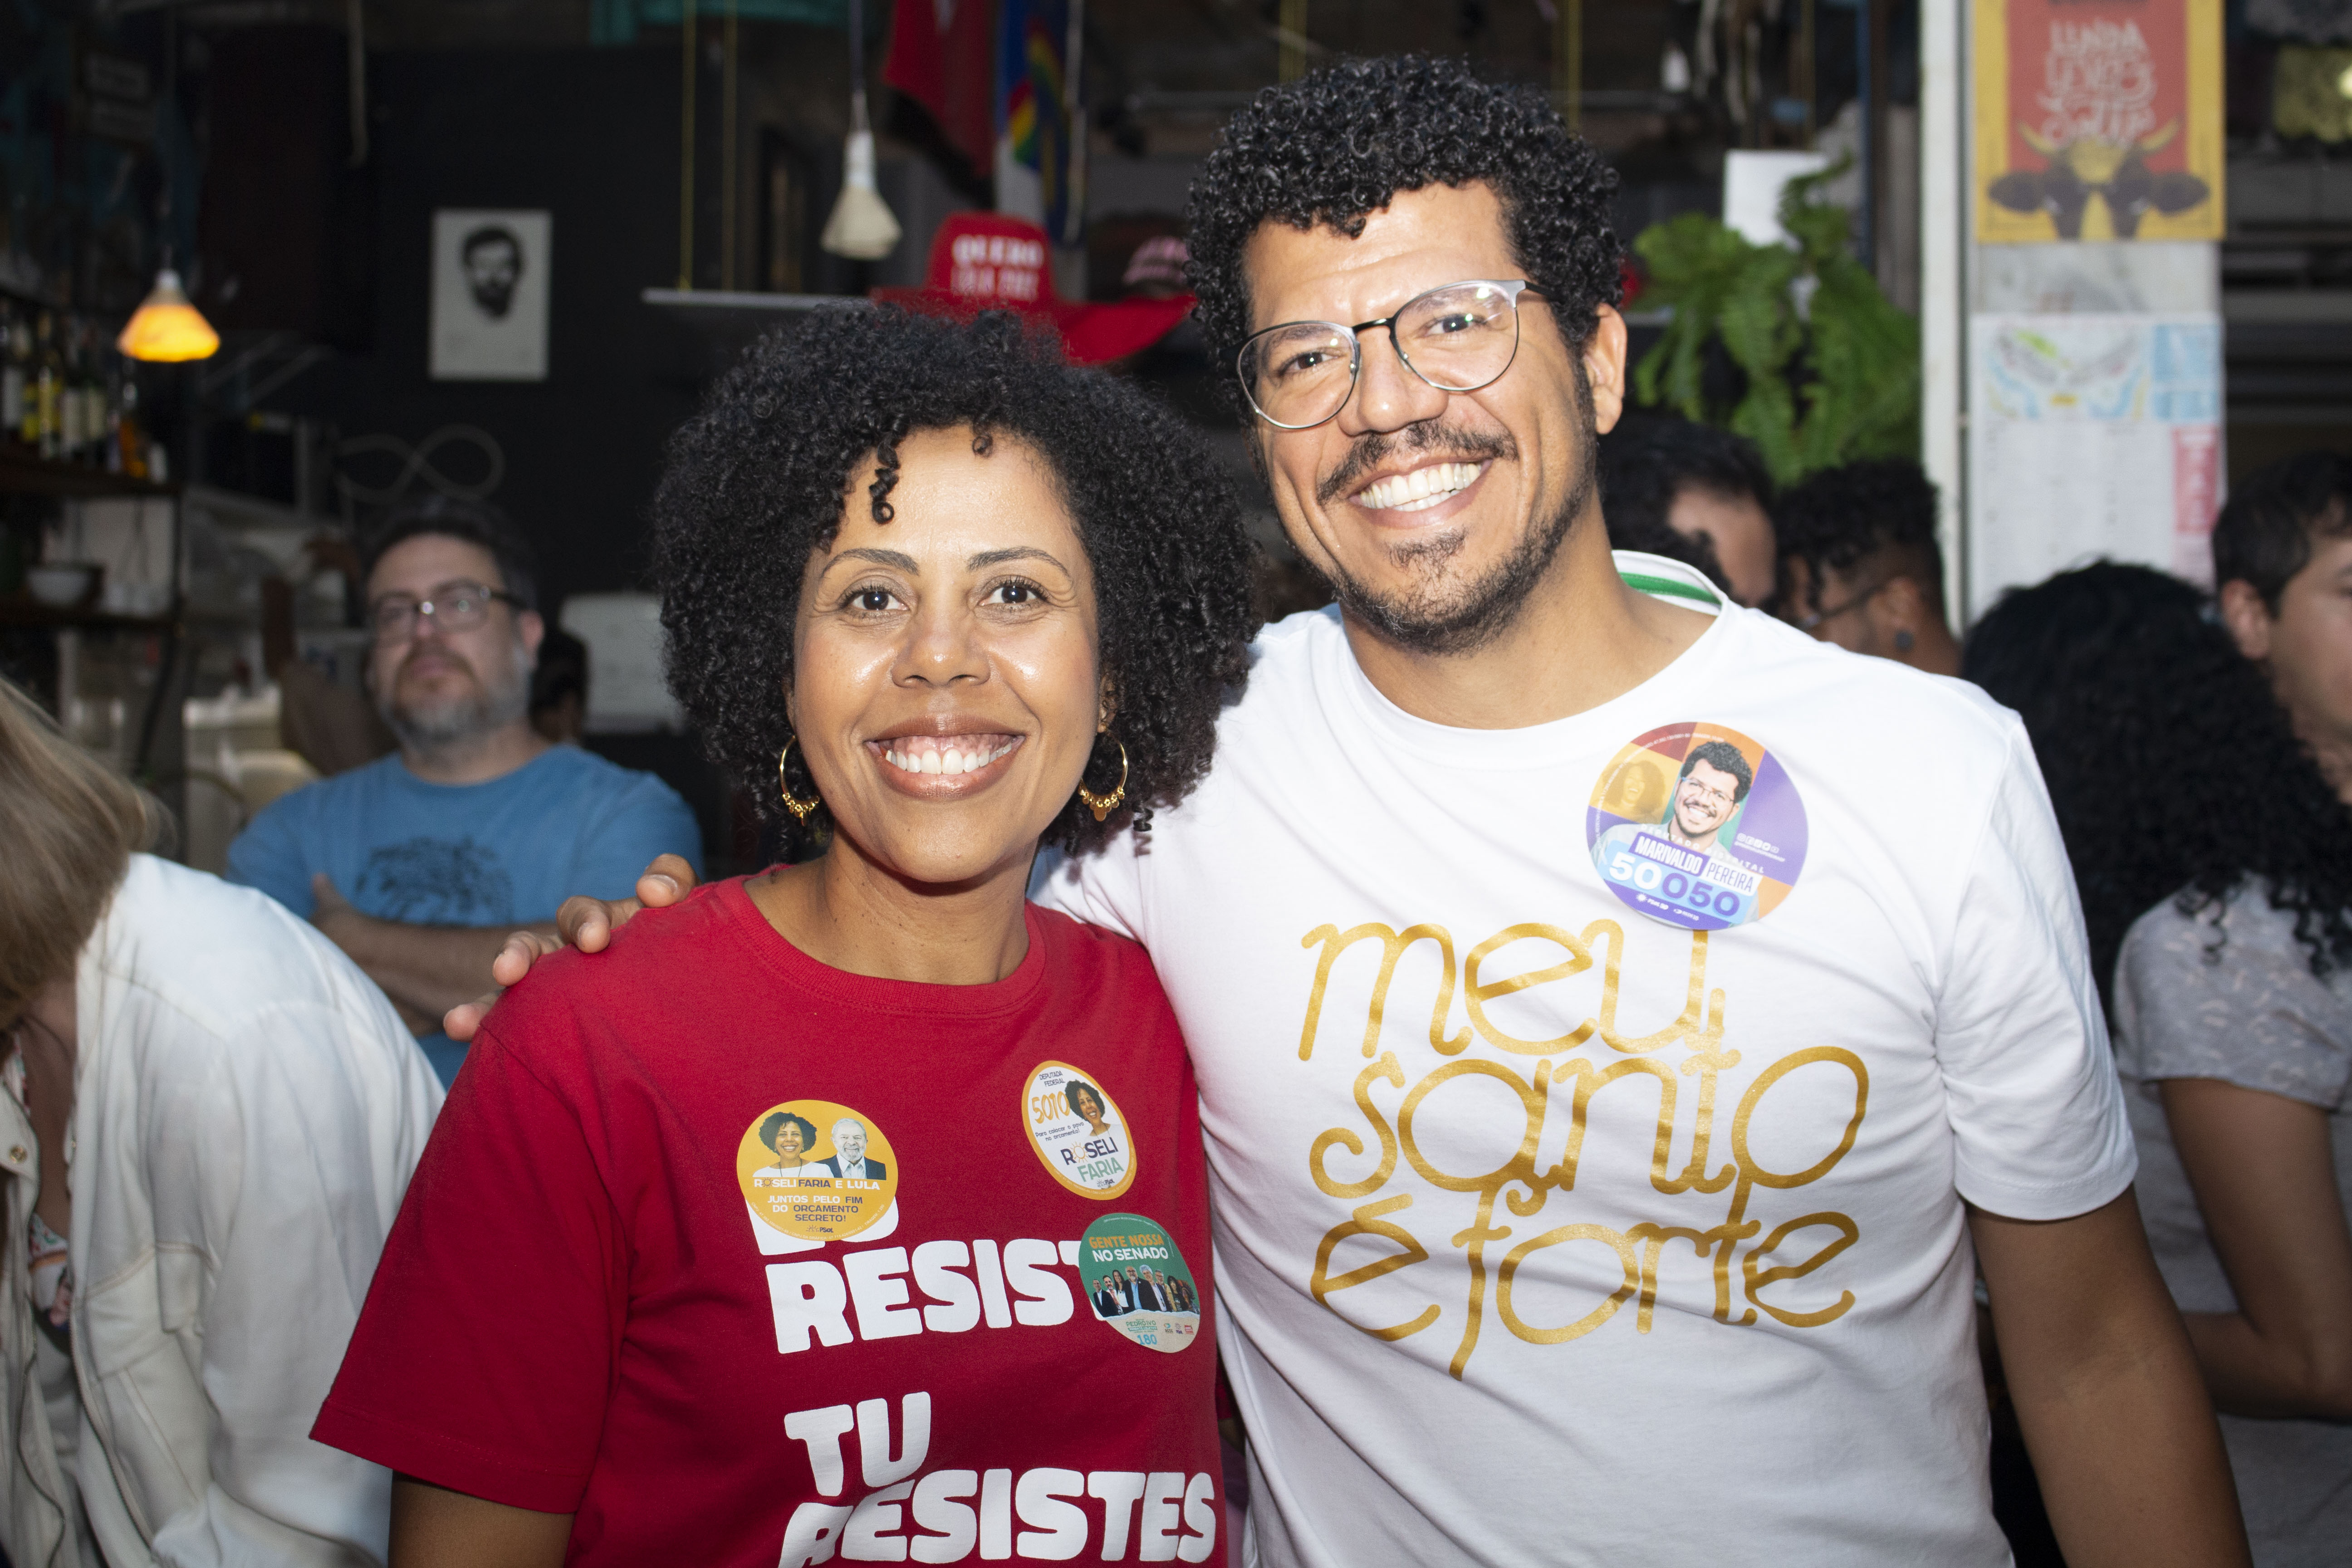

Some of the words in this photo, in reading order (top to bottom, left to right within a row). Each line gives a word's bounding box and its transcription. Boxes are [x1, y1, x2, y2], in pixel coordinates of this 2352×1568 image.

[1635, 836, 1703, 874] MARIVALDO
[1706, 863, 1754, 892] PEREIRA
[1609, 852, 1740, 916] 50050
[1298, 919, 1723, 1061] meu
[1039, 1071, 1063, 1080] DEPUTADA
[1044, 1078, 1065, 1087] FEDERAL
[1032, 1091, 1070, 1124] 5010
[1309, 988, 1869, 1200] santo
[1060, 1137, 1118, 1165] ROSELI
[1077, 1157, 1124, 1182] FARIA
[754, 1178, 796, 1188] ROSELI
[799, 1179, 831, 1188] FARIA
[836, 1180, 843, 1189] E
[847, 1181, 880, 1190] LULA
[794, 1205, 858, 1213] ORÇAMENTO
[1089, 1235, 1128, 1249] GENTE
[1128, 1234, 1164, 1247] NOSSA
[1092, 1250, 1113, 1262] NO
[1114, 1247, 1168, 1261] SENADO
[1311, 1194, 1441, 1341] é
[1450, 1168, 1859, 1381] forte
[1137, 1334, 1157, 1345] 180
[784, 1391, 931, 1496] TU
[778, 1467, 1216, 1568] RESISTES
